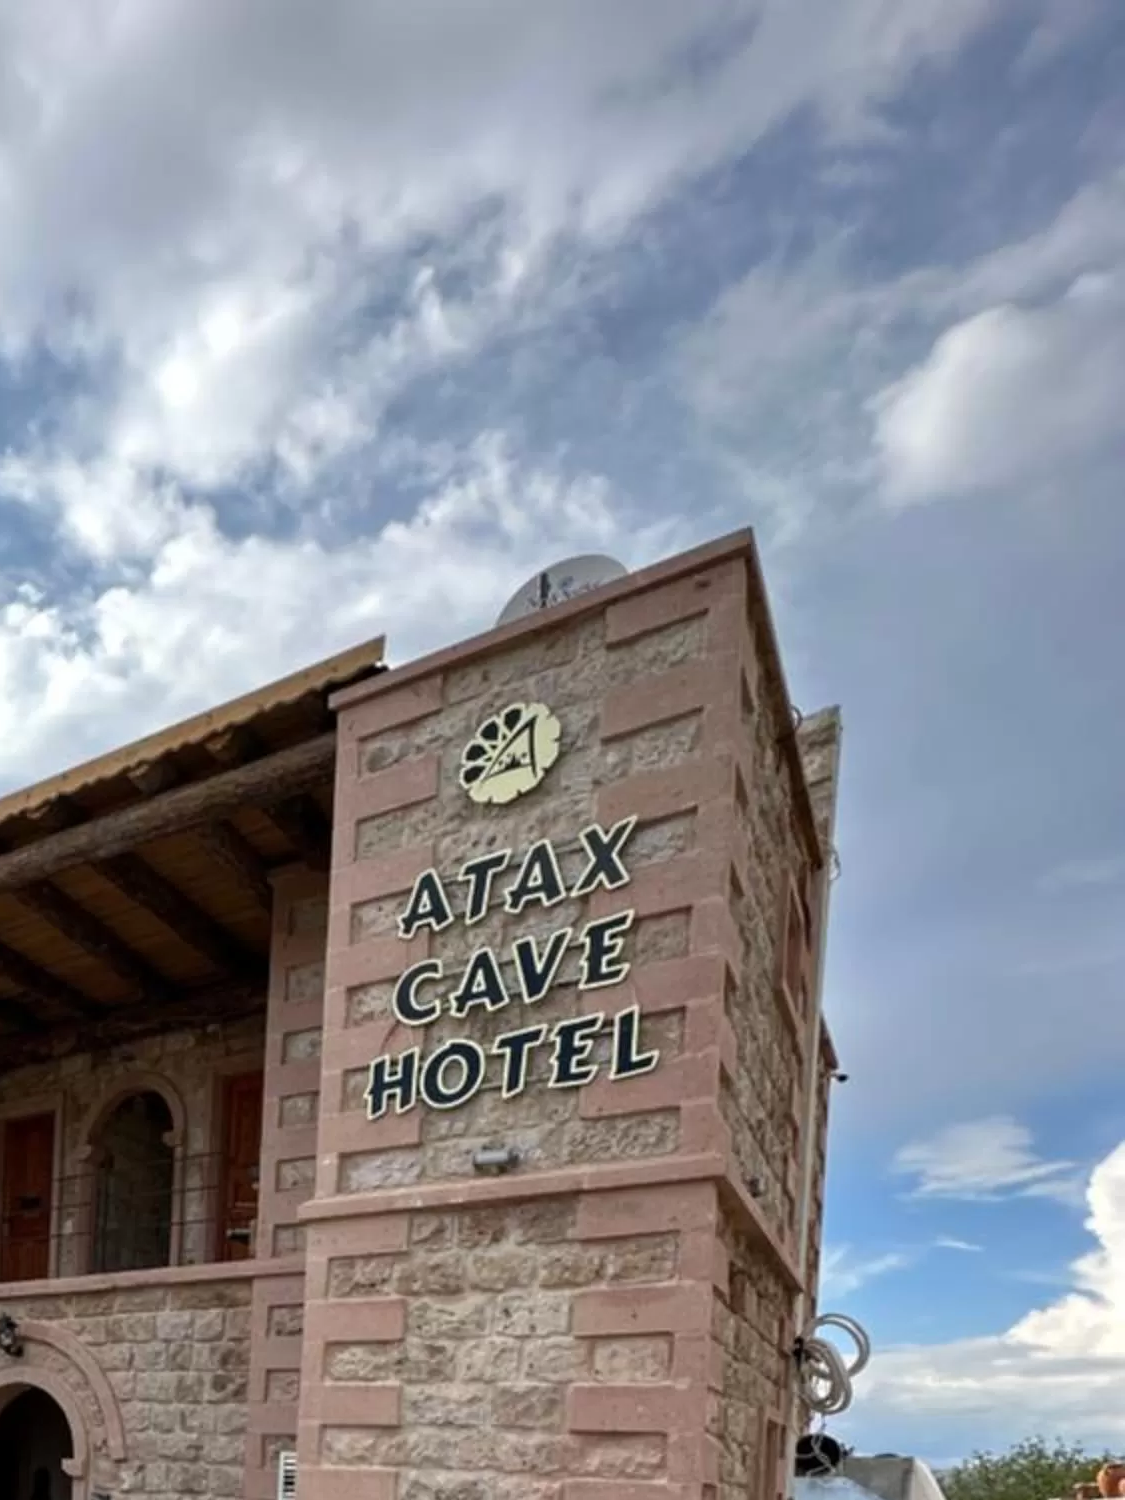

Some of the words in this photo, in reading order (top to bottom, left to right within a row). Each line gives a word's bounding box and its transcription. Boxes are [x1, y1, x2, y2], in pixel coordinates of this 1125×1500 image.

[399, 817, 637, 938] ATAX
[393, 911, 634, 1025] CAVE
[365, 1006, 659, 1120] HOTEL
